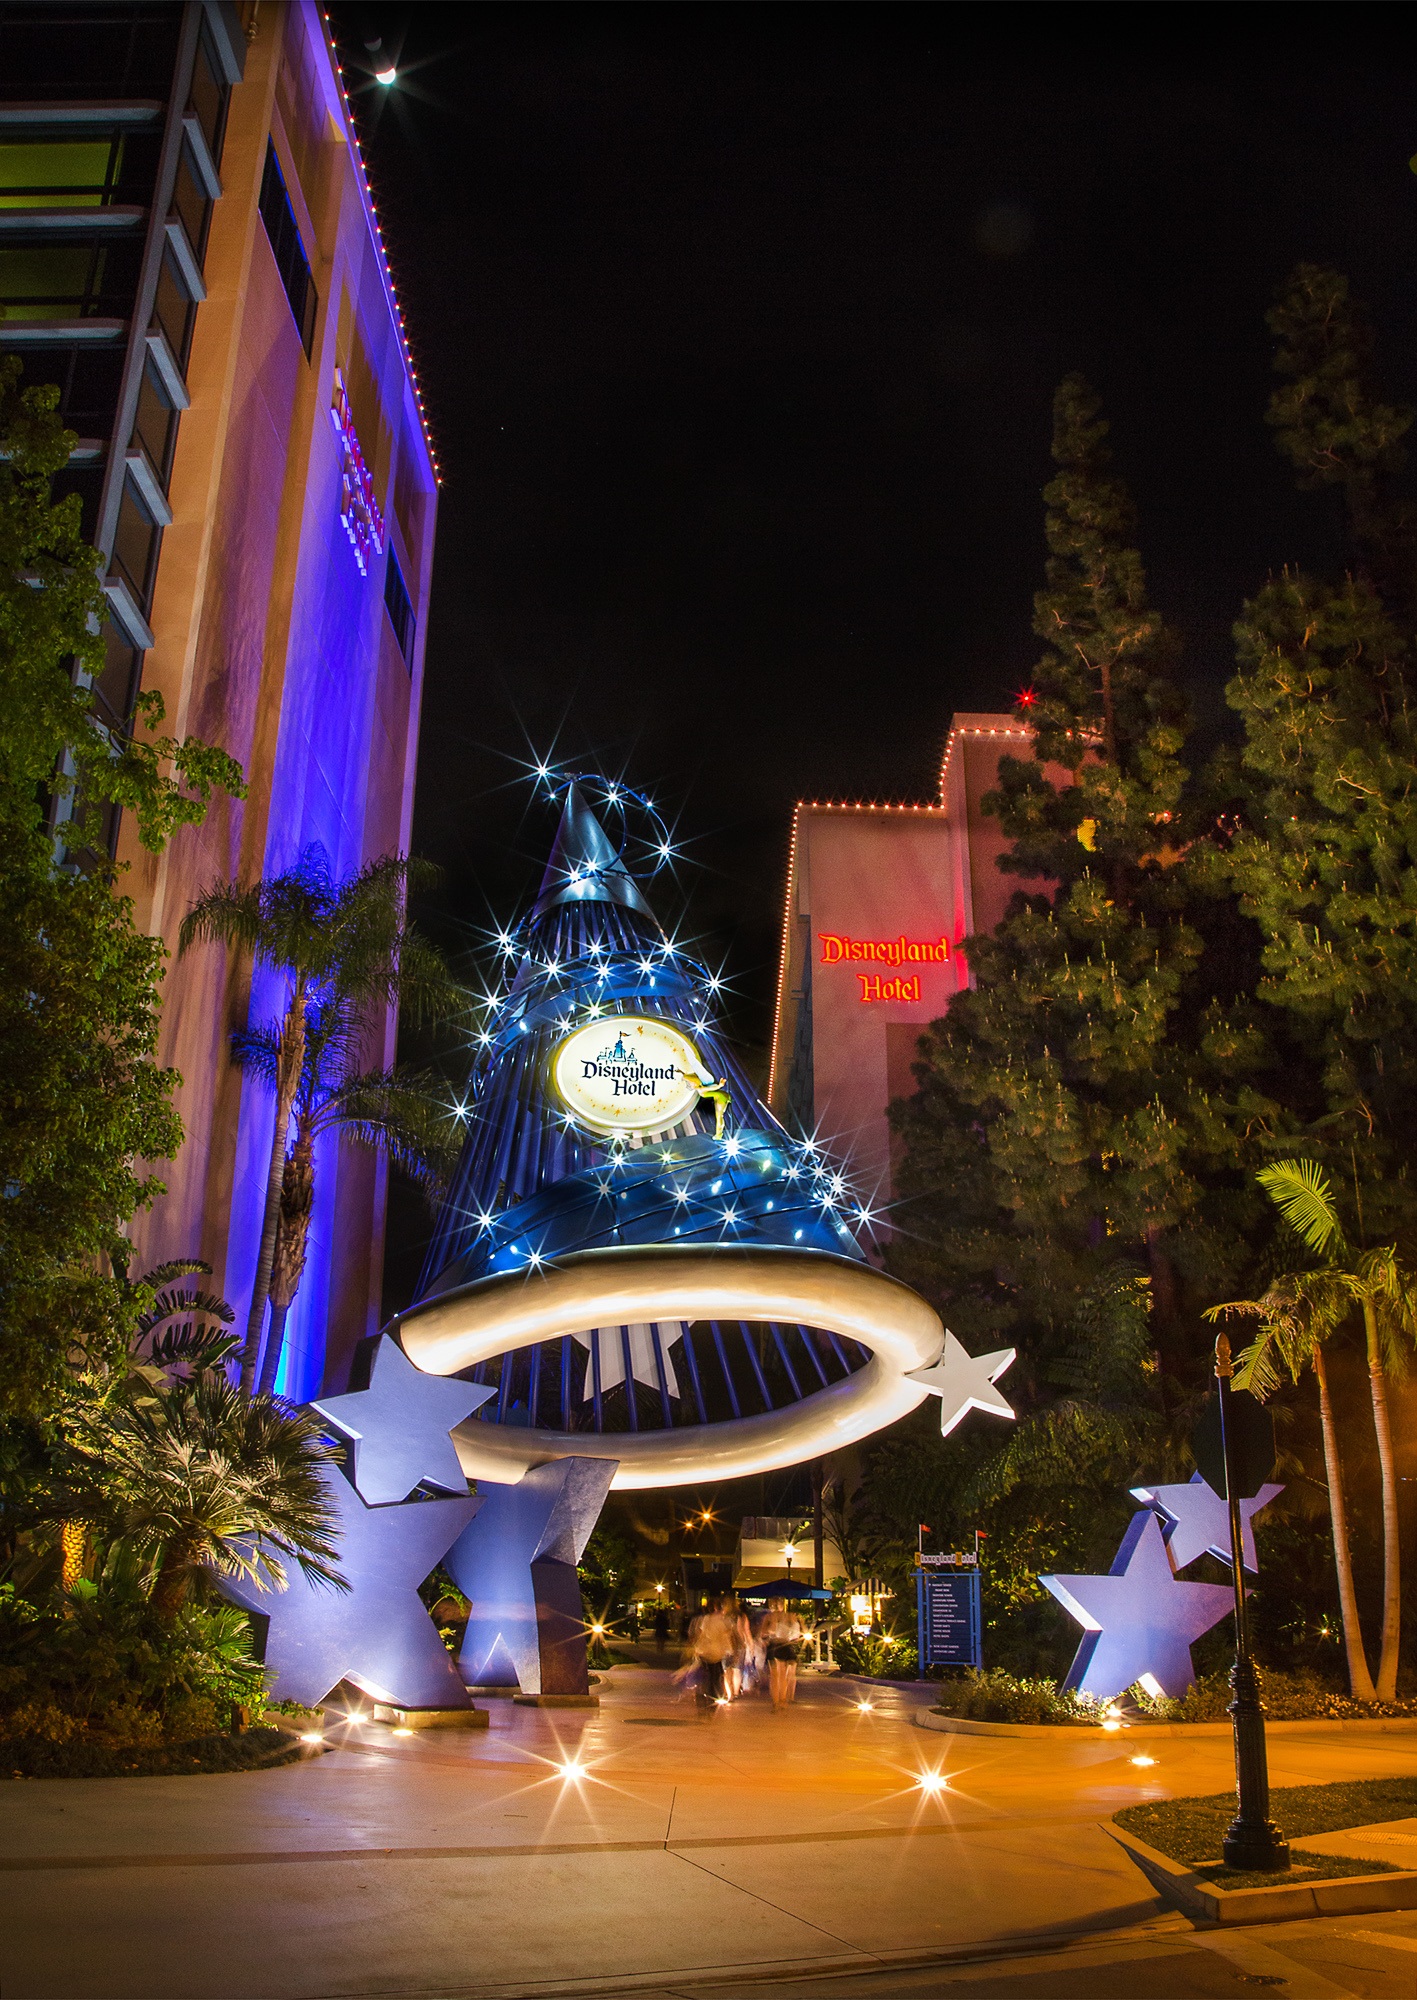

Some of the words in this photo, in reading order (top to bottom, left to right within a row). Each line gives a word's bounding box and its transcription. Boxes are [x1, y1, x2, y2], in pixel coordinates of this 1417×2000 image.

[818, 933, 949, 967] Disneyland
[856, 973, 921, 1003] Hotel
[580, 1059, 675, 1082] Disneyland
[610, 1078, 656, 1096] Hotel
[914, 1552, 956, 1566] Disneyland
[955, 1552, 977, 1566] Hotel
